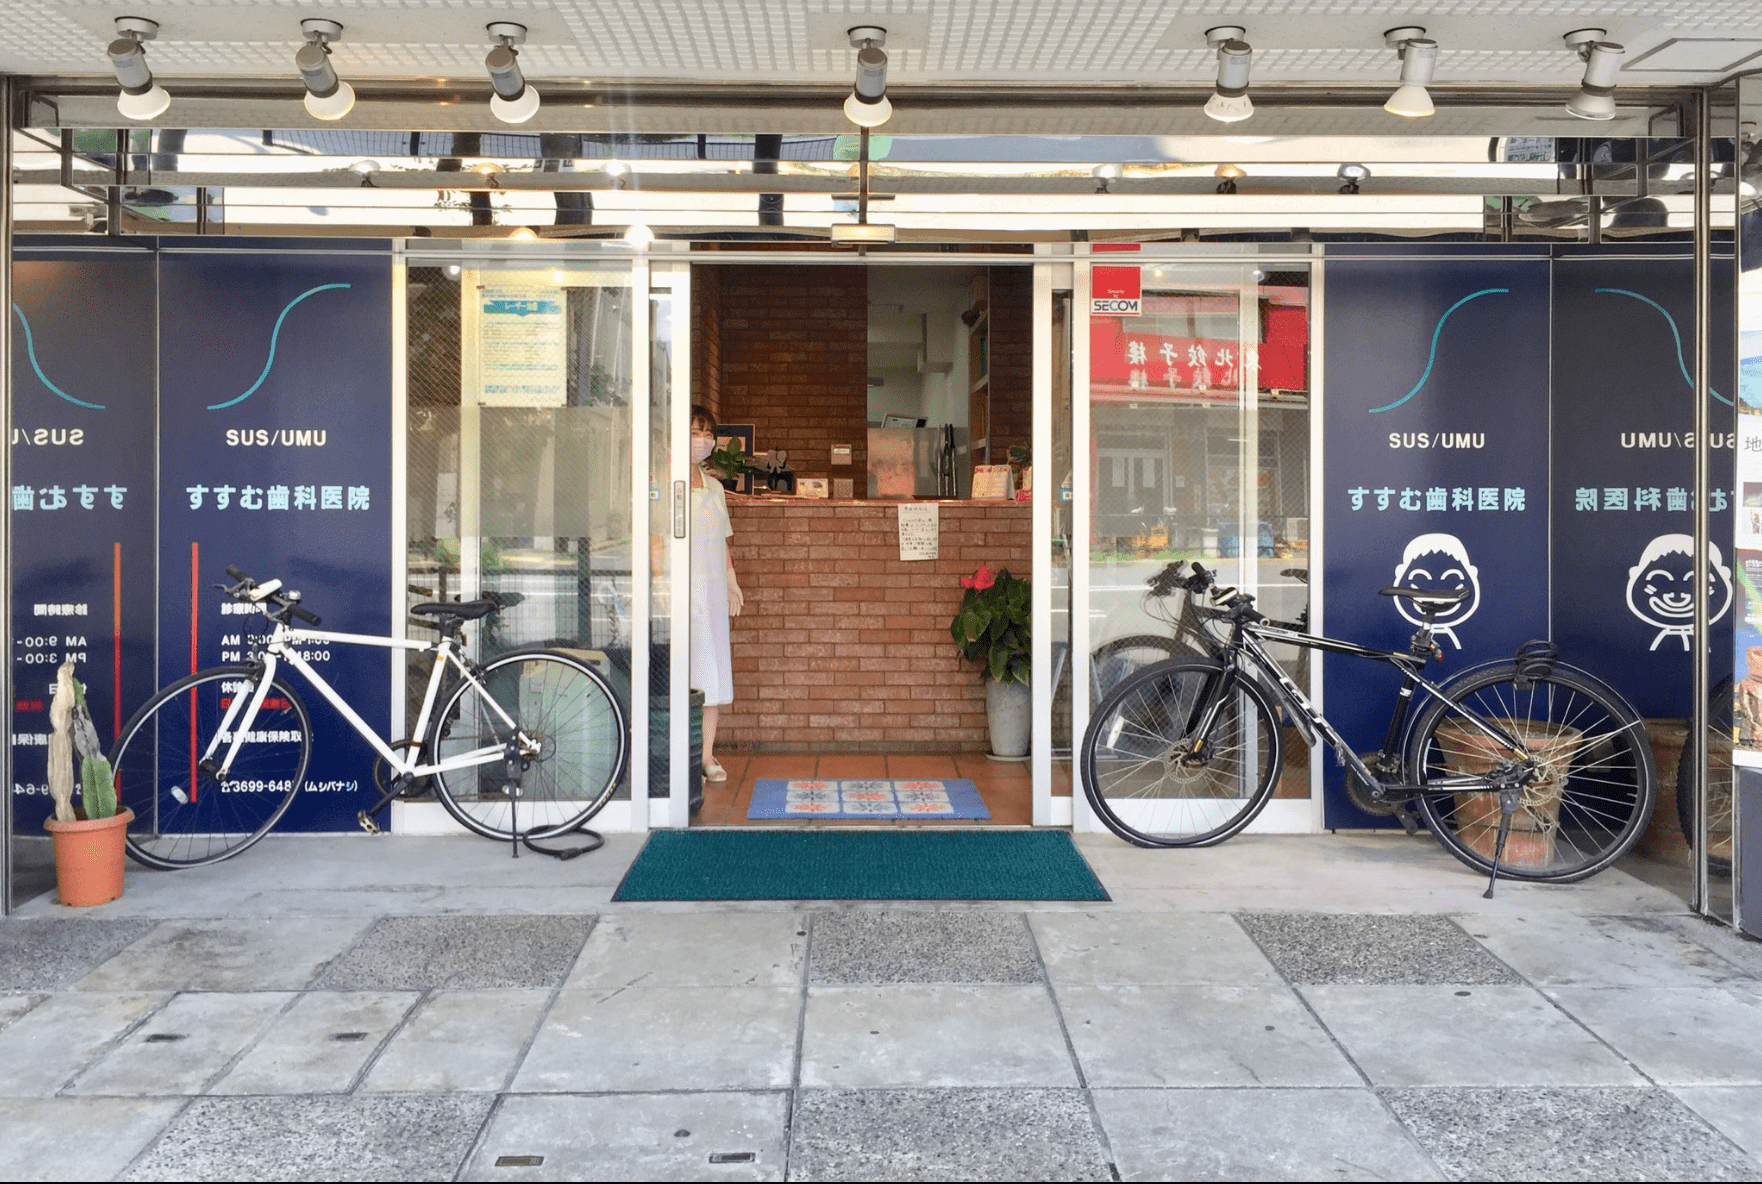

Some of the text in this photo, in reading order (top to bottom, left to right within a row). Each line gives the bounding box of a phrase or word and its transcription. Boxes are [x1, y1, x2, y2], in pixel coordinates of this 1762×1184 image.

[1094, 300, 1138, 311] SECOM
[226, 429, 327, 446] SUS/UMU
[1389, 432, 1485, 449] SUS/UMU
[186, 484, 370, 511] すすむ歯科医院
[1347, 486, 1526, 512] すすむ歯科医院
[221, 634, 241, 646] AM
[221, 651, 241, 662] PM
